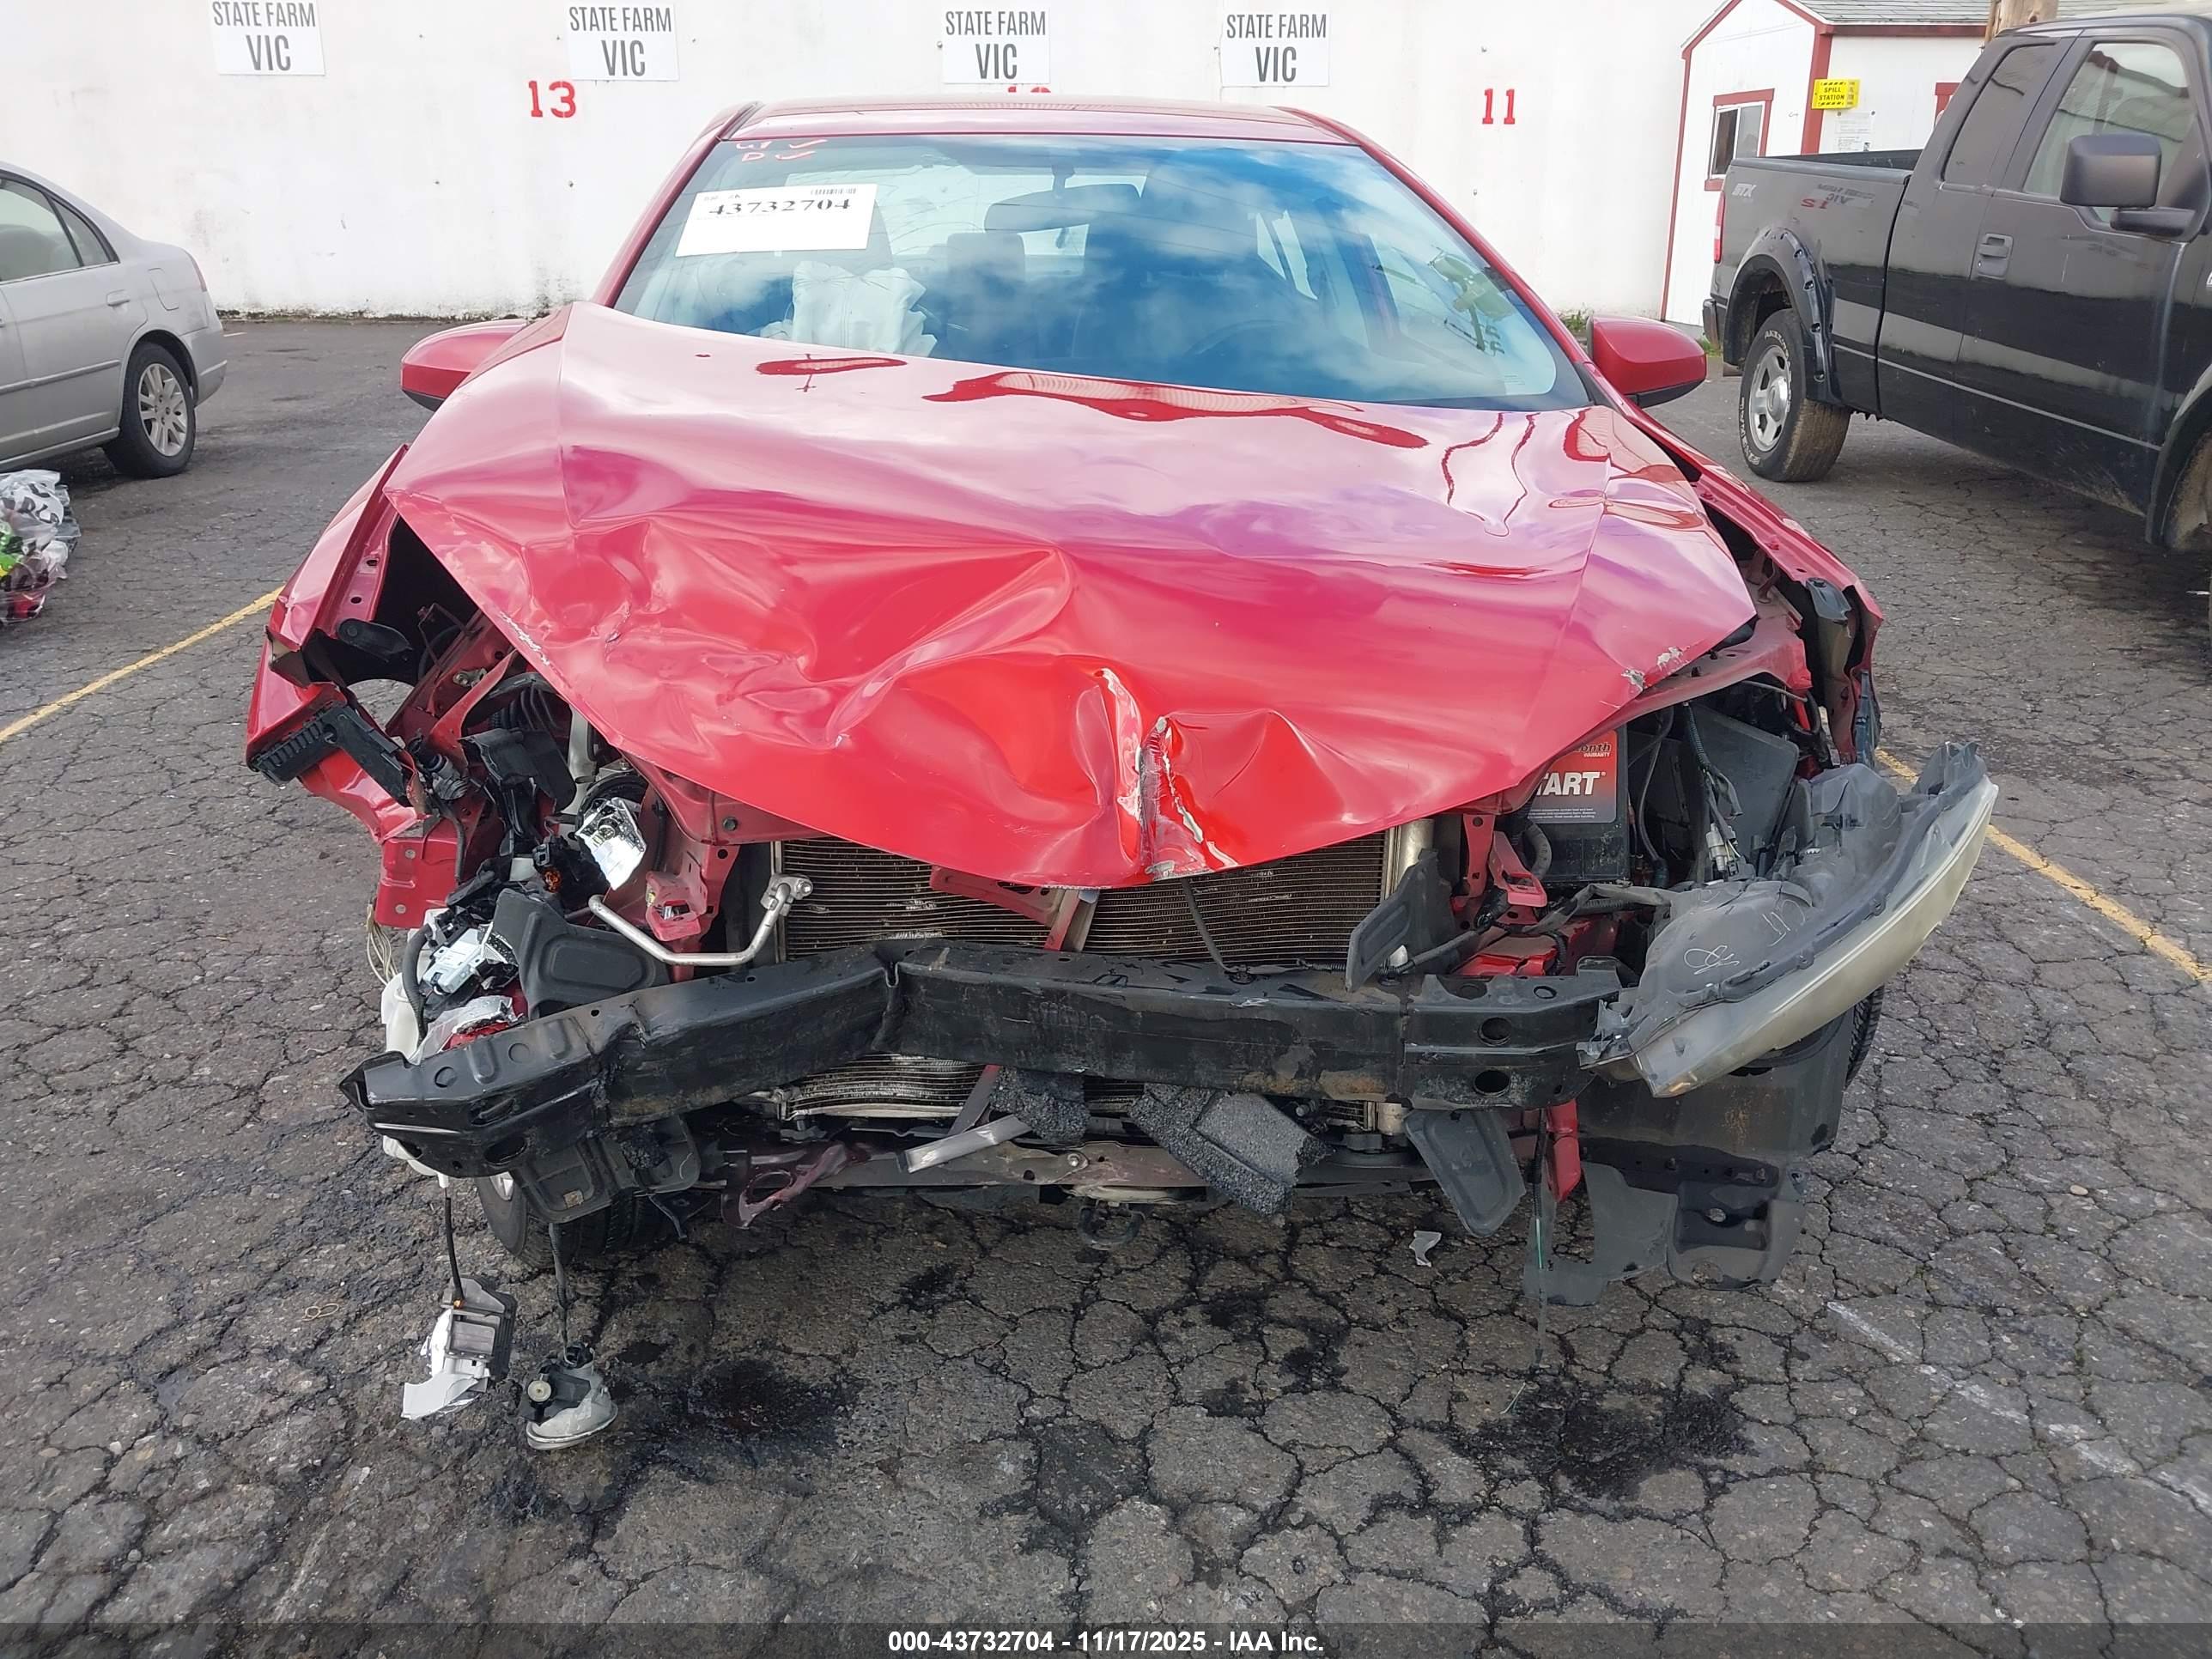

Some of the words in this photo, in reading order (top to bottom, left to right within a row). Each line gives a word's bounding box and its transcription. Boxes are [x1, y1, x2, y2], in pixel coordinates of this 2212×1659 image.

[213, 1, 261, 27] STATE
[266, 1, 315, 27] FARM
[568, 6, 617, 33] STATE
[623, 6, 672, 33] FARM
[945, 10, 993, 36] STATE
[998, 10, 1046, 36] FARM
[1226, 13, 1273, 39] STATE
[1279, 13, 1327, 39] FARM
[246, 34, 290, 71] VIC
[601, 40, 646, 77] VIC
[975, 43, 1018, 80] VIC
[1255, 46, 1297, 82] VIC
[528, 80, 577, 118] 13
[1481, 88, 1516, 125] 11
[1731, 183, 1757, 198] STX
[708, 198, 850, 215] 43732704
